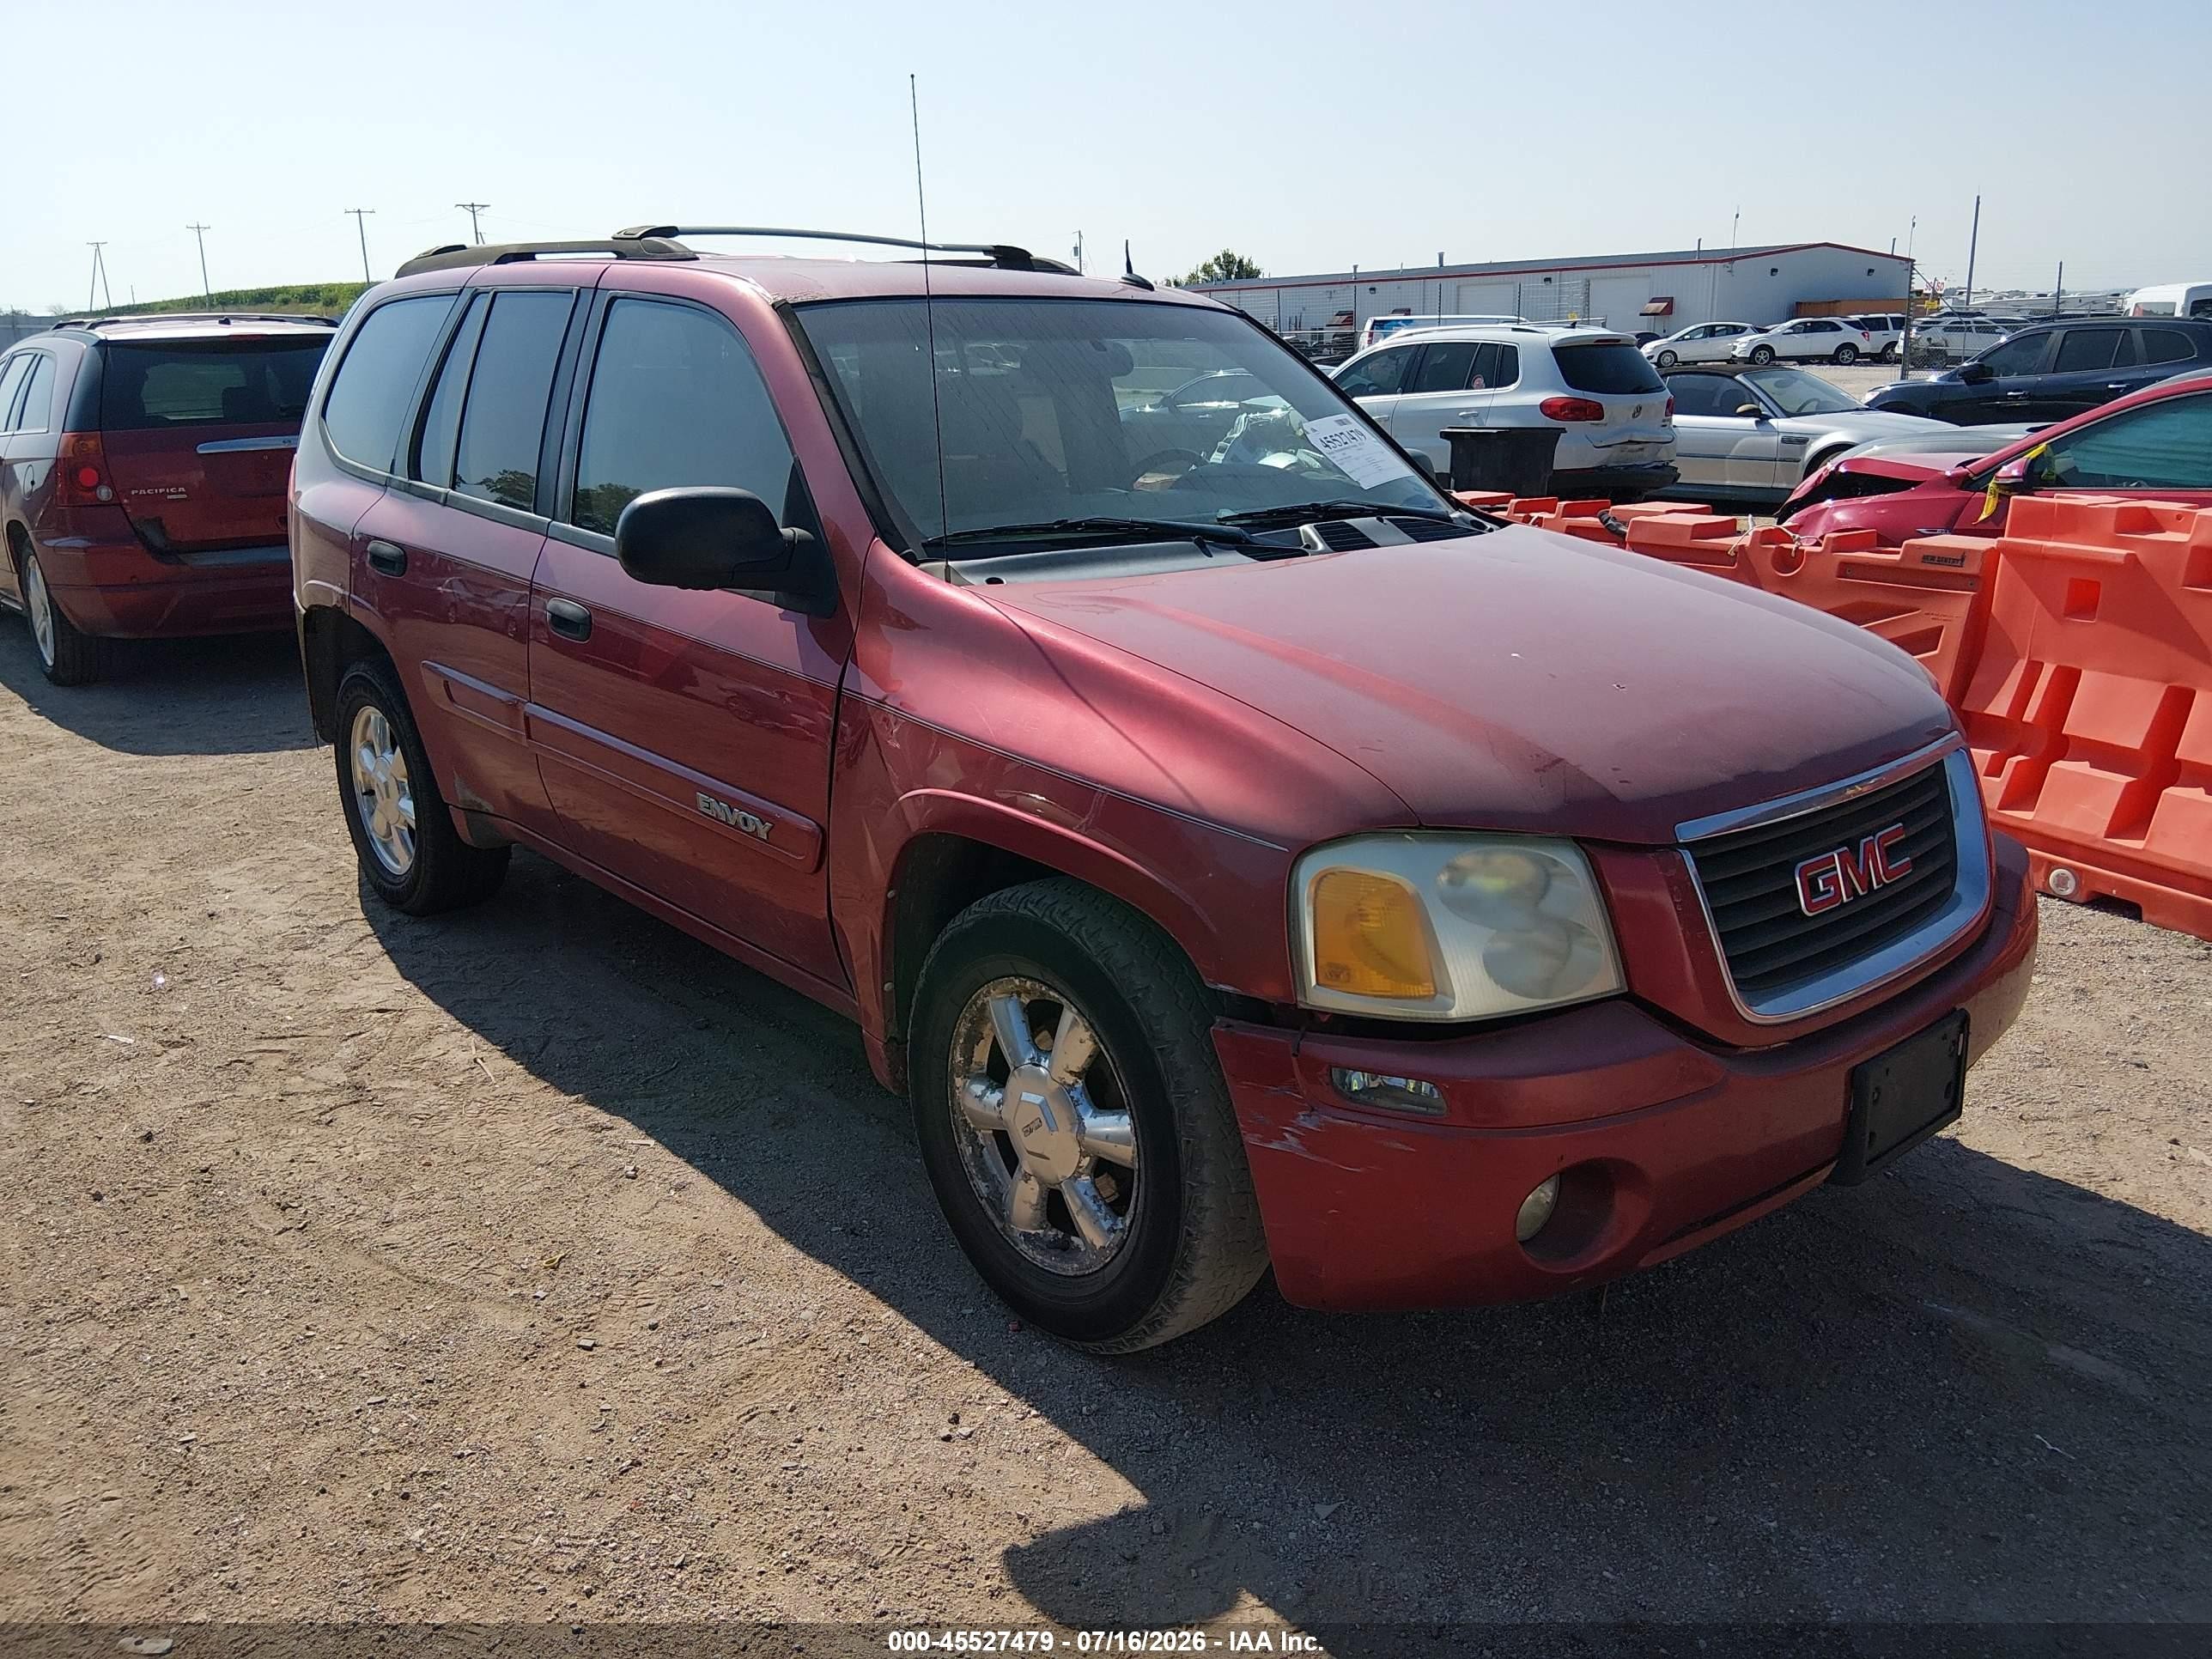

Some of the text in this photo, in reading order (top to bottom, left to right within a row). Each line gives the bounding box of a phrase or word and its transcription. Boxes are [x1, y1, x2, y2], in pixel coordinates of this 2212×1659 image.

[1319, 428, 1367, 449] 45527479
[696, 792, 774, 840] ENVOY
[1795, 823, 1912, 916] GMC
